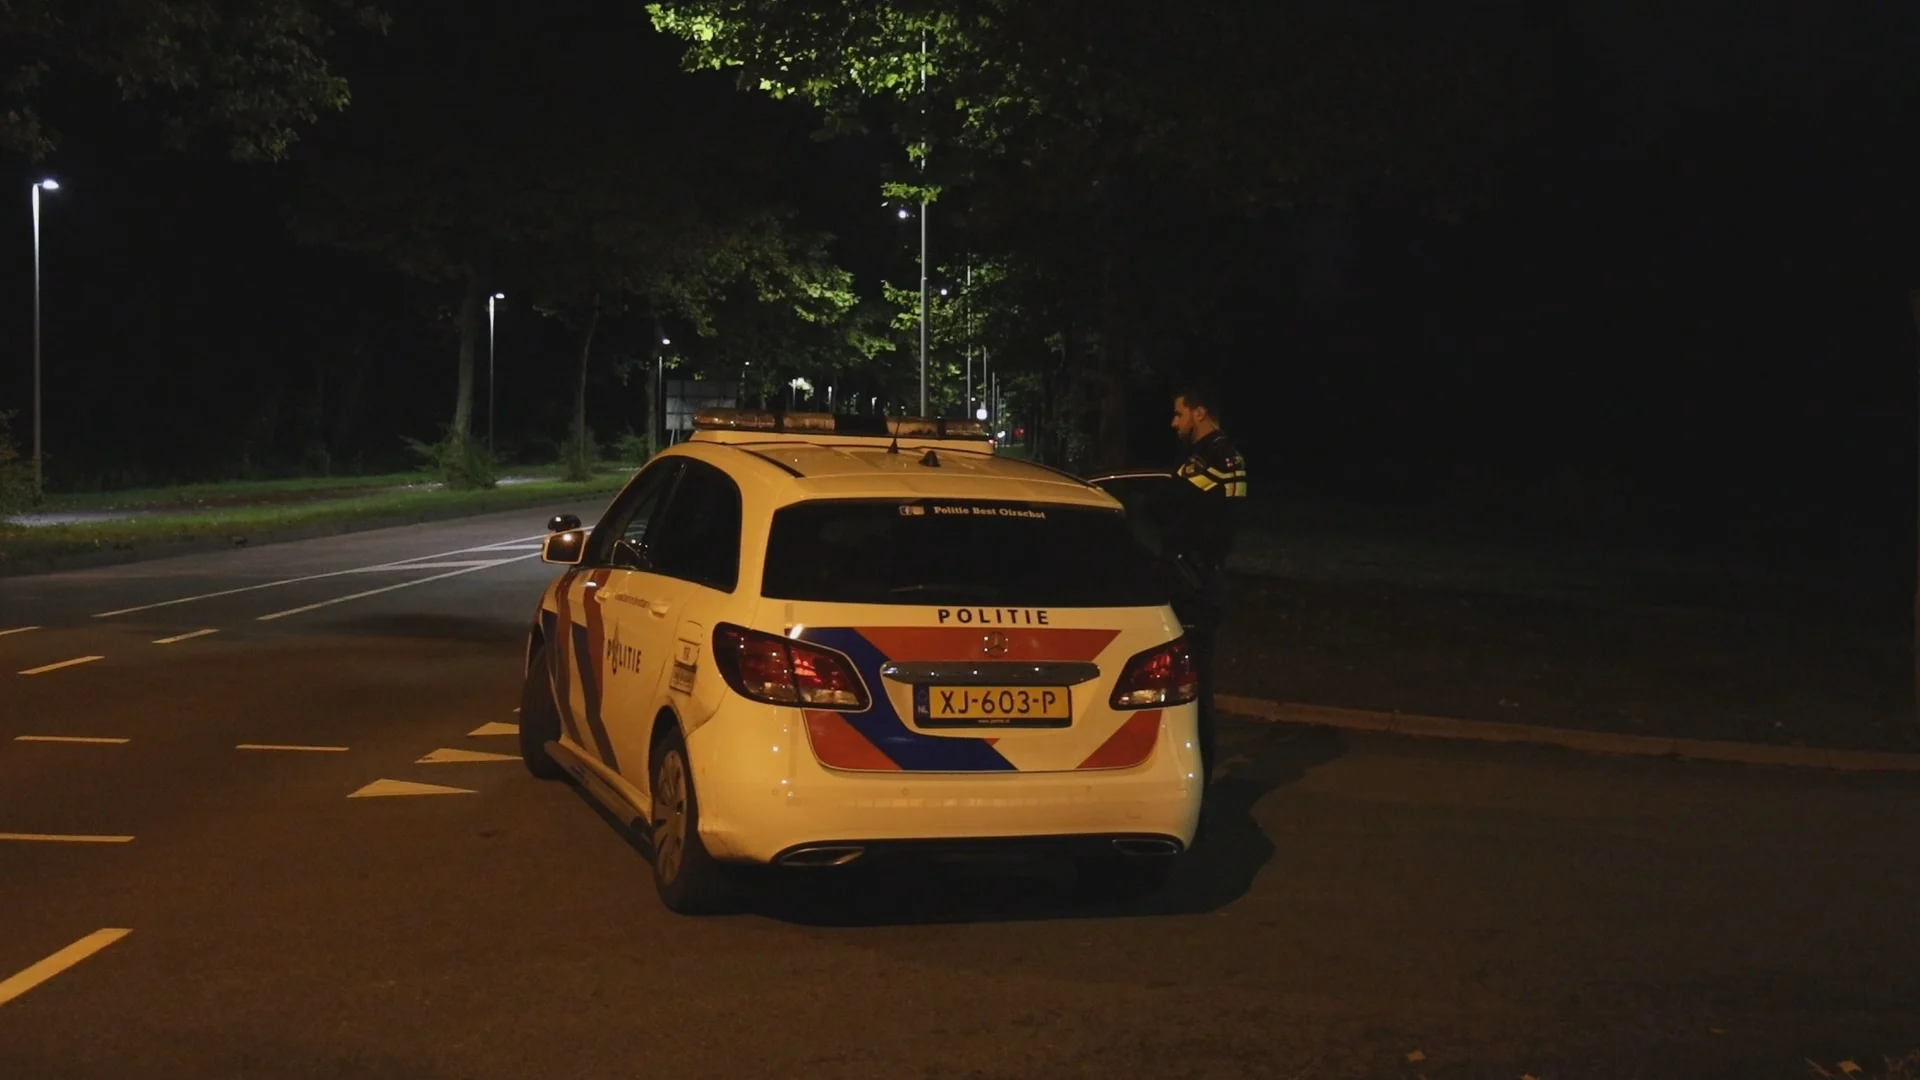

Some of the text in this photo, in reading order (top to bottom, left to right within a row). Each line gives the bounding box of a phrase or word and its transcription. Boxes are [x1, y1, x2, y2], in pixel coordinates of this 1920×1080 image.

[933, 505, 970, 515] Politie
[972, 506, 997, 516] Best
[938, 608, 1049, 625] POLITIE
[940, 689, 1057, 715] XJ-603-P
